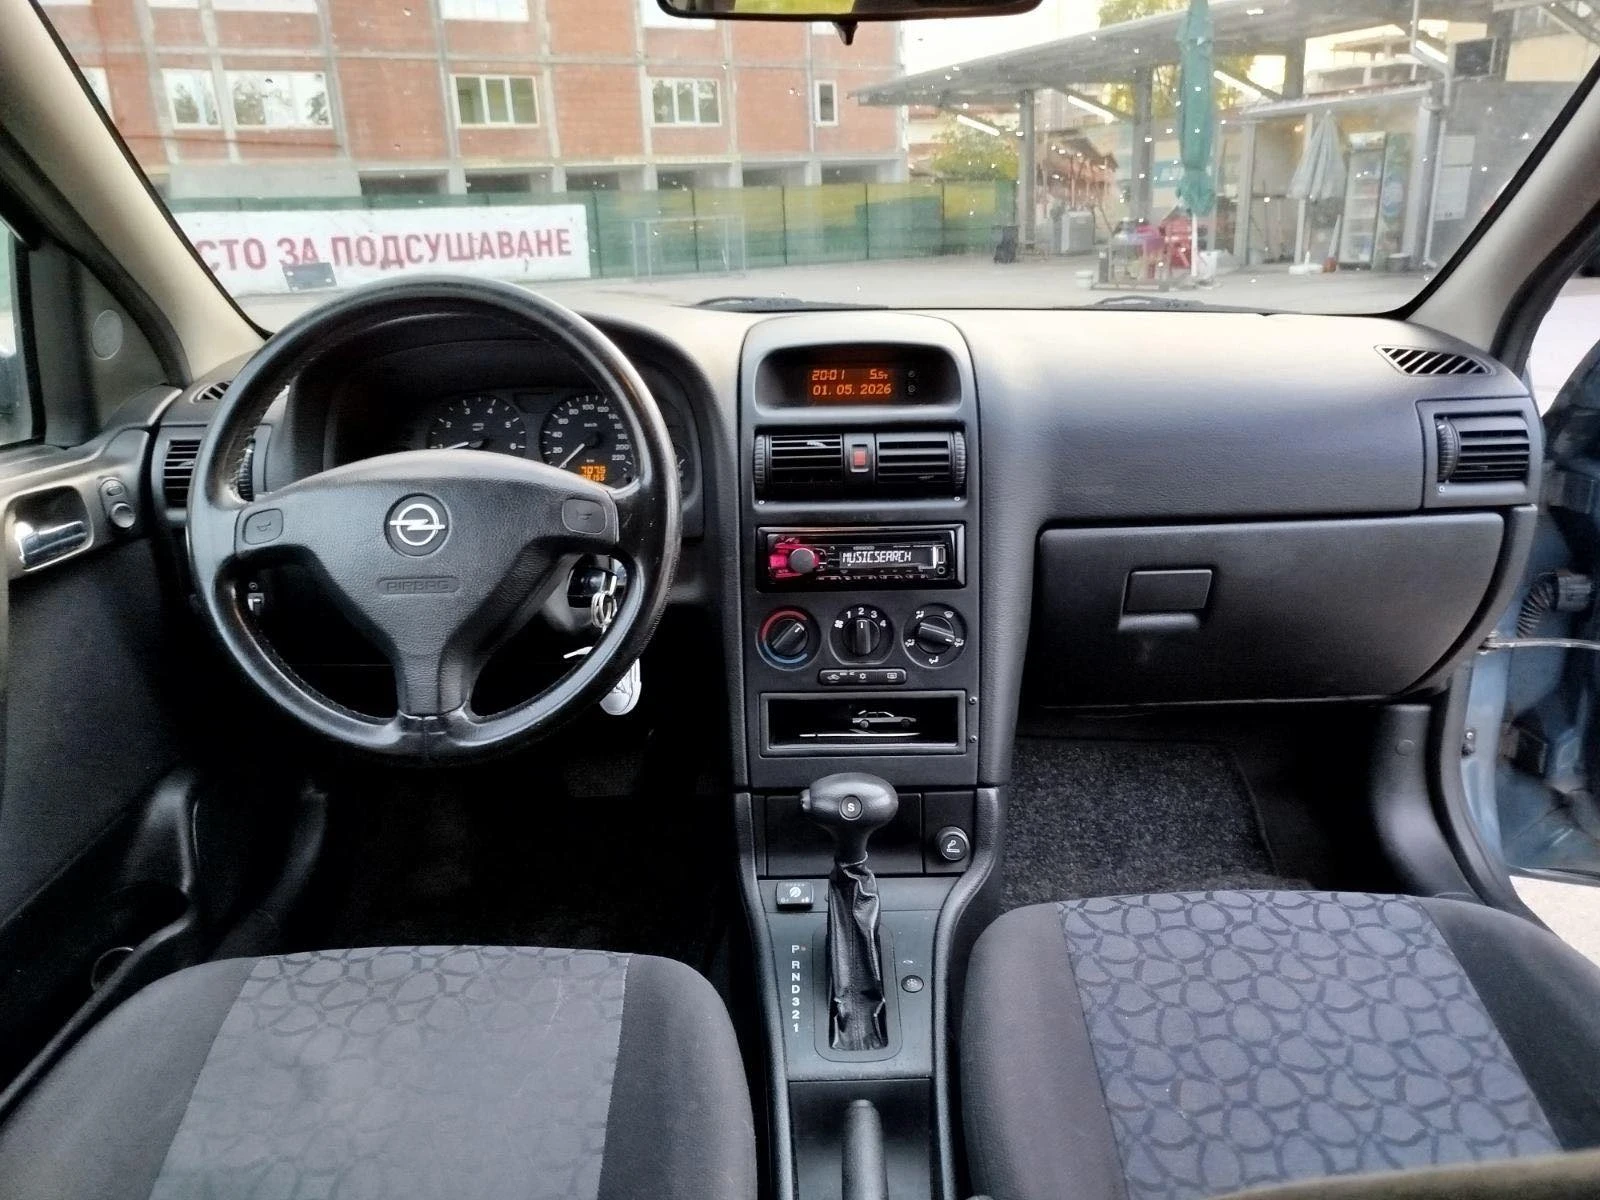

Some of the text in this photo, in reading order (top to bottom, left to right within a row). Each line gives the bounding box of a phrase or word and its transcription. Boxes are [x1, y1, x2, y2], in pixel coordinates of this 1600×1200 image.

[277, 237, 320, 265] ЗА
[331, 228, 572, 269] ПОДСУШАВАНЕ
[860, 383, 892, 395] 2026
[464, 407, 471, 415] 3
[504, 421, 511, 429] 5
[509, 442, 517, 450] 6
[552, 446, 563, 454] 20
[615, 443, 630, 451] 200
[846, 611, 852, 619] 1
[858, 607, 865, 615] 2
[870, 610, 878, 619] 3
[880, 619, 887, 628] 4
[847, 802, 855, 812] S
[791, 945, 800, 954] P
[791, 960, 801, 970] R
[791, 972, 801, 982] N
[791, 984, 801, 994] D
[791, 997, 801, 1007] 3
[791, 1009, 801, 1019] 2
[793, 1022, 799, 1033] 1
